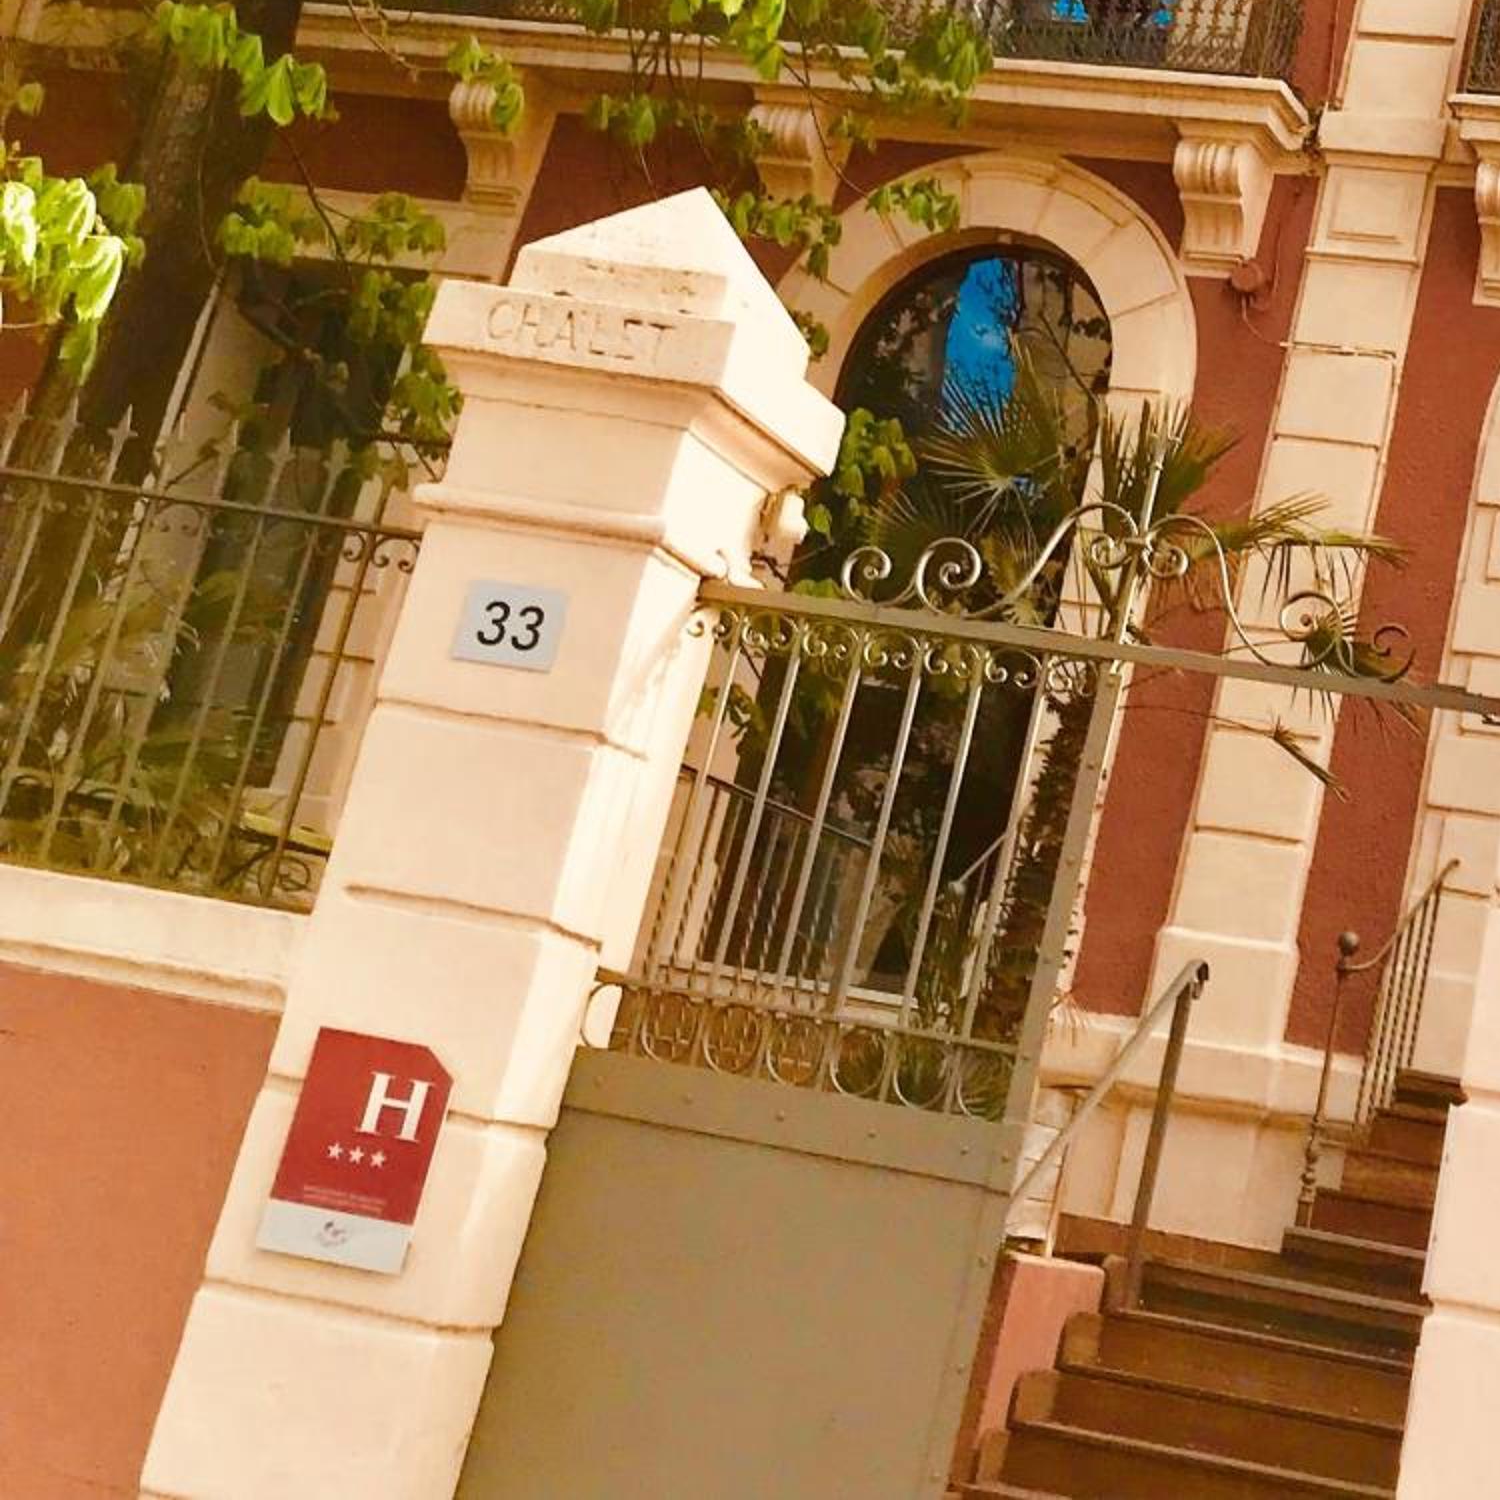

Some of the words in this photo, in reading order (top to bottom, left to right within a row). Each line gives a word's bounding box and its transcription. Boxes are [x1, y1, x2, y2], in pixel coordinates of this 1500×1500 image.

[488, 300, 675, 366] CHALET
[476, 600, 545, 651] 33
[356, 1072, 434, 1142] H
